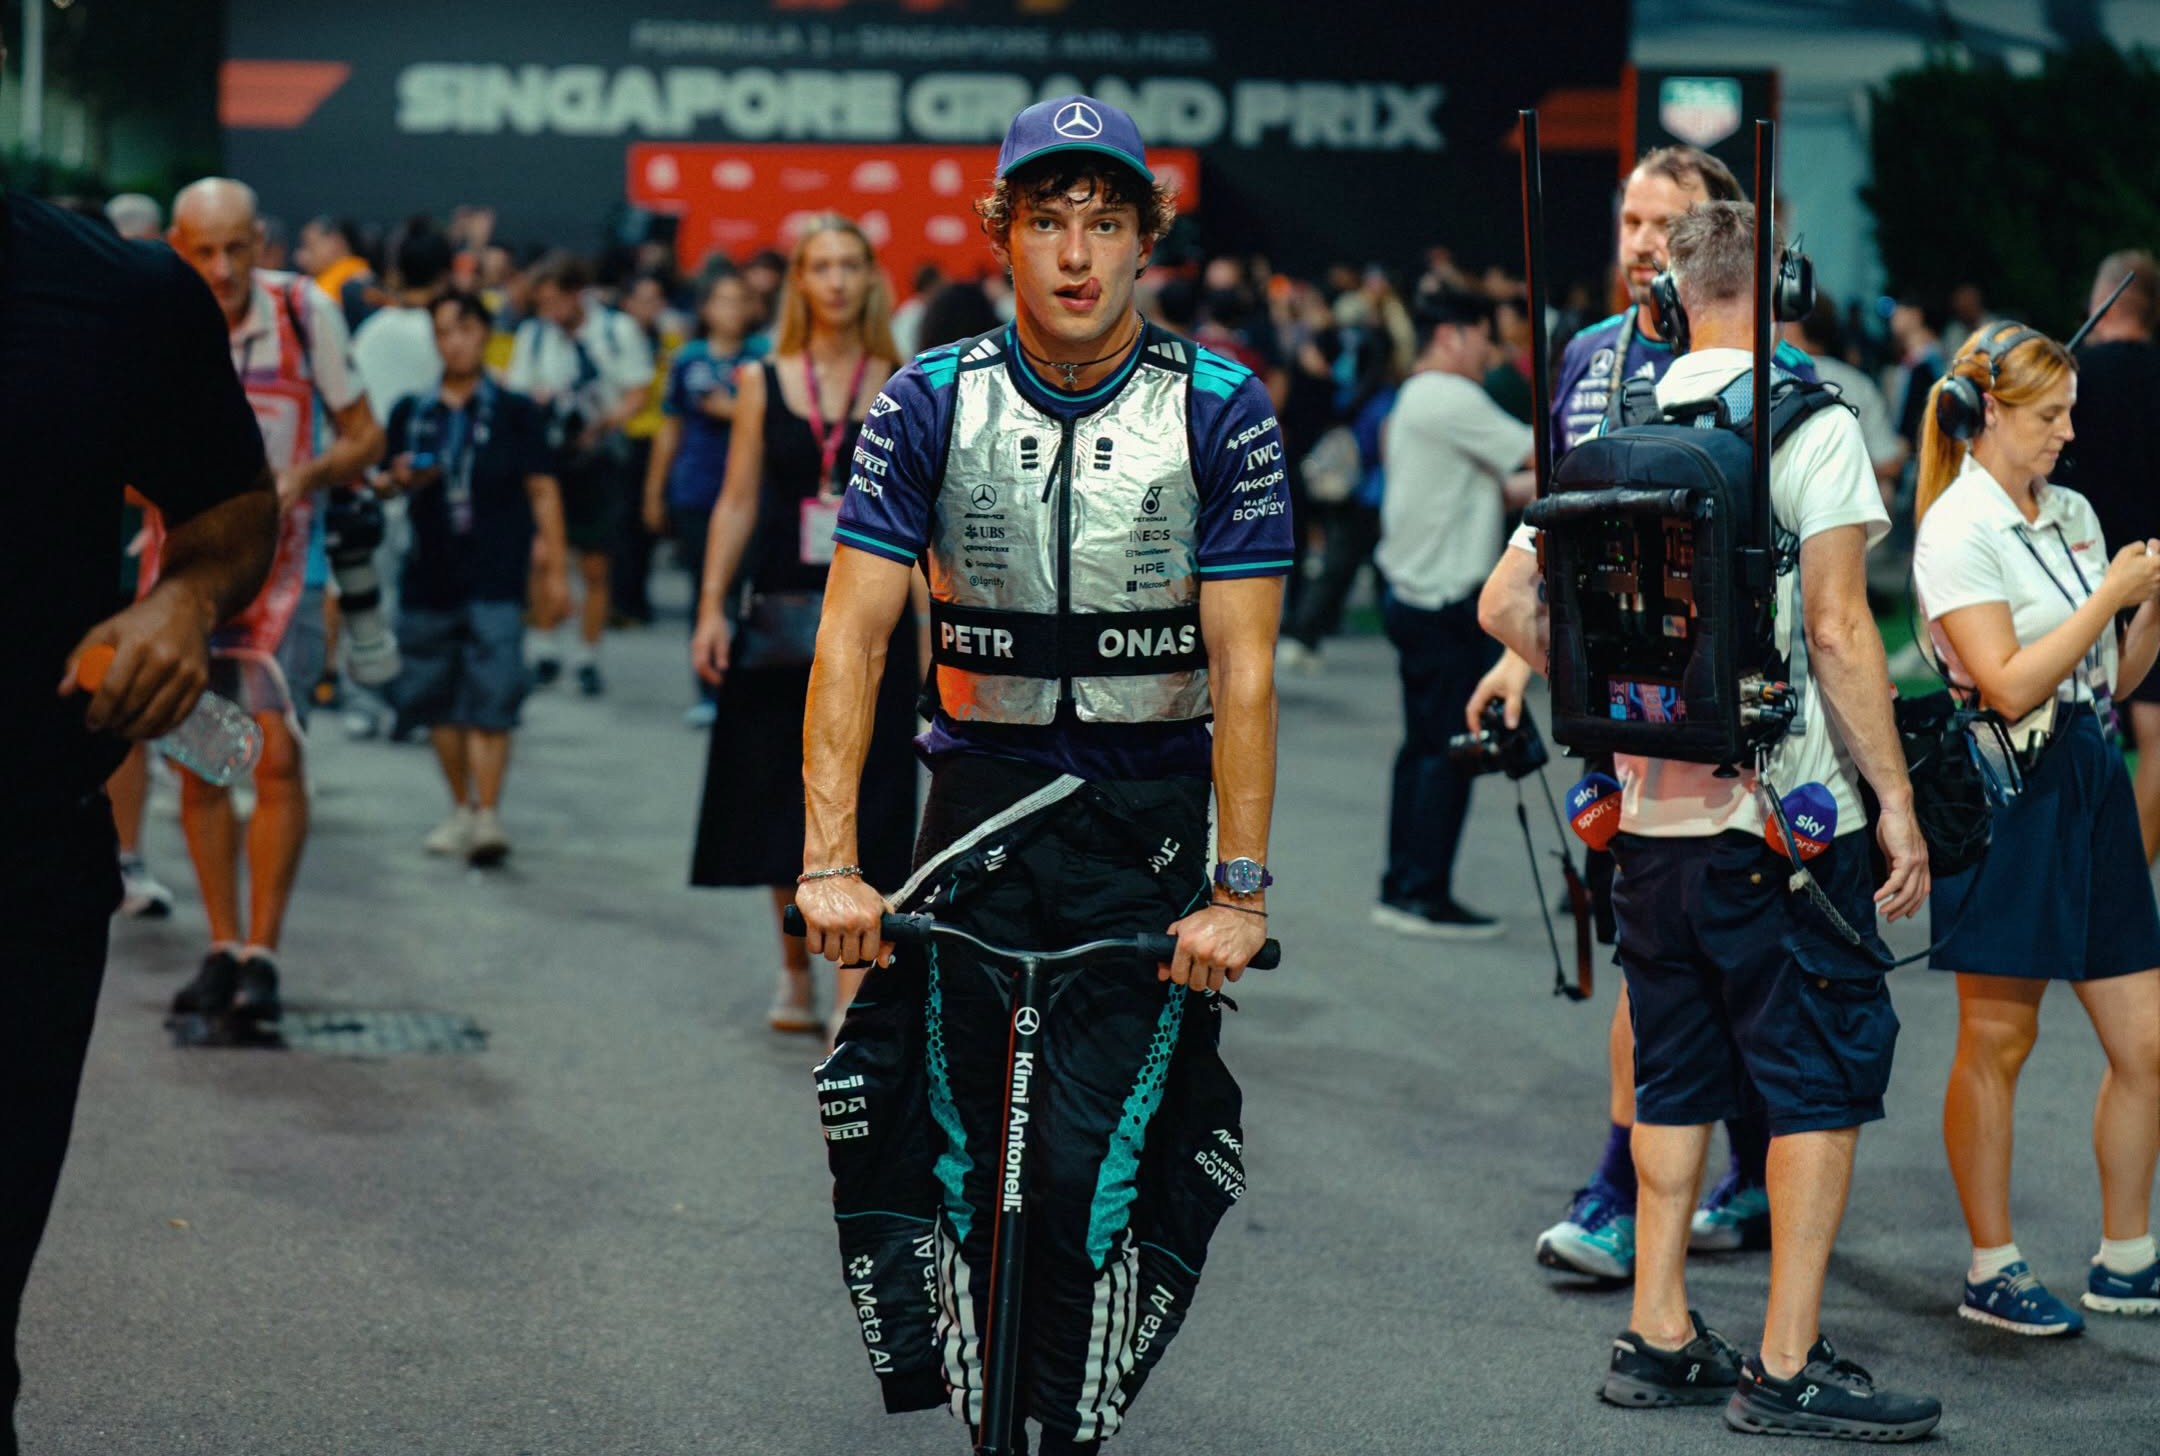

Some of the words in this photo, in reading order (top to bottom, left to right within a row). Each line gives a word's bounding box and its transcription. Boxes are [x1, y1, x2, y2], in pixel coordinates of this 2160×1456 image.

[396, 63, 901, 139] SINGAPORE
[1232, 79, 1448, 150] PRIX
[1246, 441, 1281, 471] IWC
[979, 526, 1005, 539] UBS
[1128, 529, 1171, 543] INEOS
[1133, 561, 1165, 575] HPE
[1138, 579, 1171, 590] Microsoft
[940, 621, 1014, 658] PETR
[1098, 624, 1197, 658] ONAS
[1573, 783, 1599, 808] sky
[1794, 814, 1826, 838] sky
[1011, 1051, 1034, 1104] Kimi
[1194, 1150, 1245, 1200] BONVO
[1209, 1149, 1244, 1182] MARRIO
[851, 1283, 883, 1344] Meta
[869, 1348, 895, 1374] AI
[1134, 1313, 1163, 1361] eta
